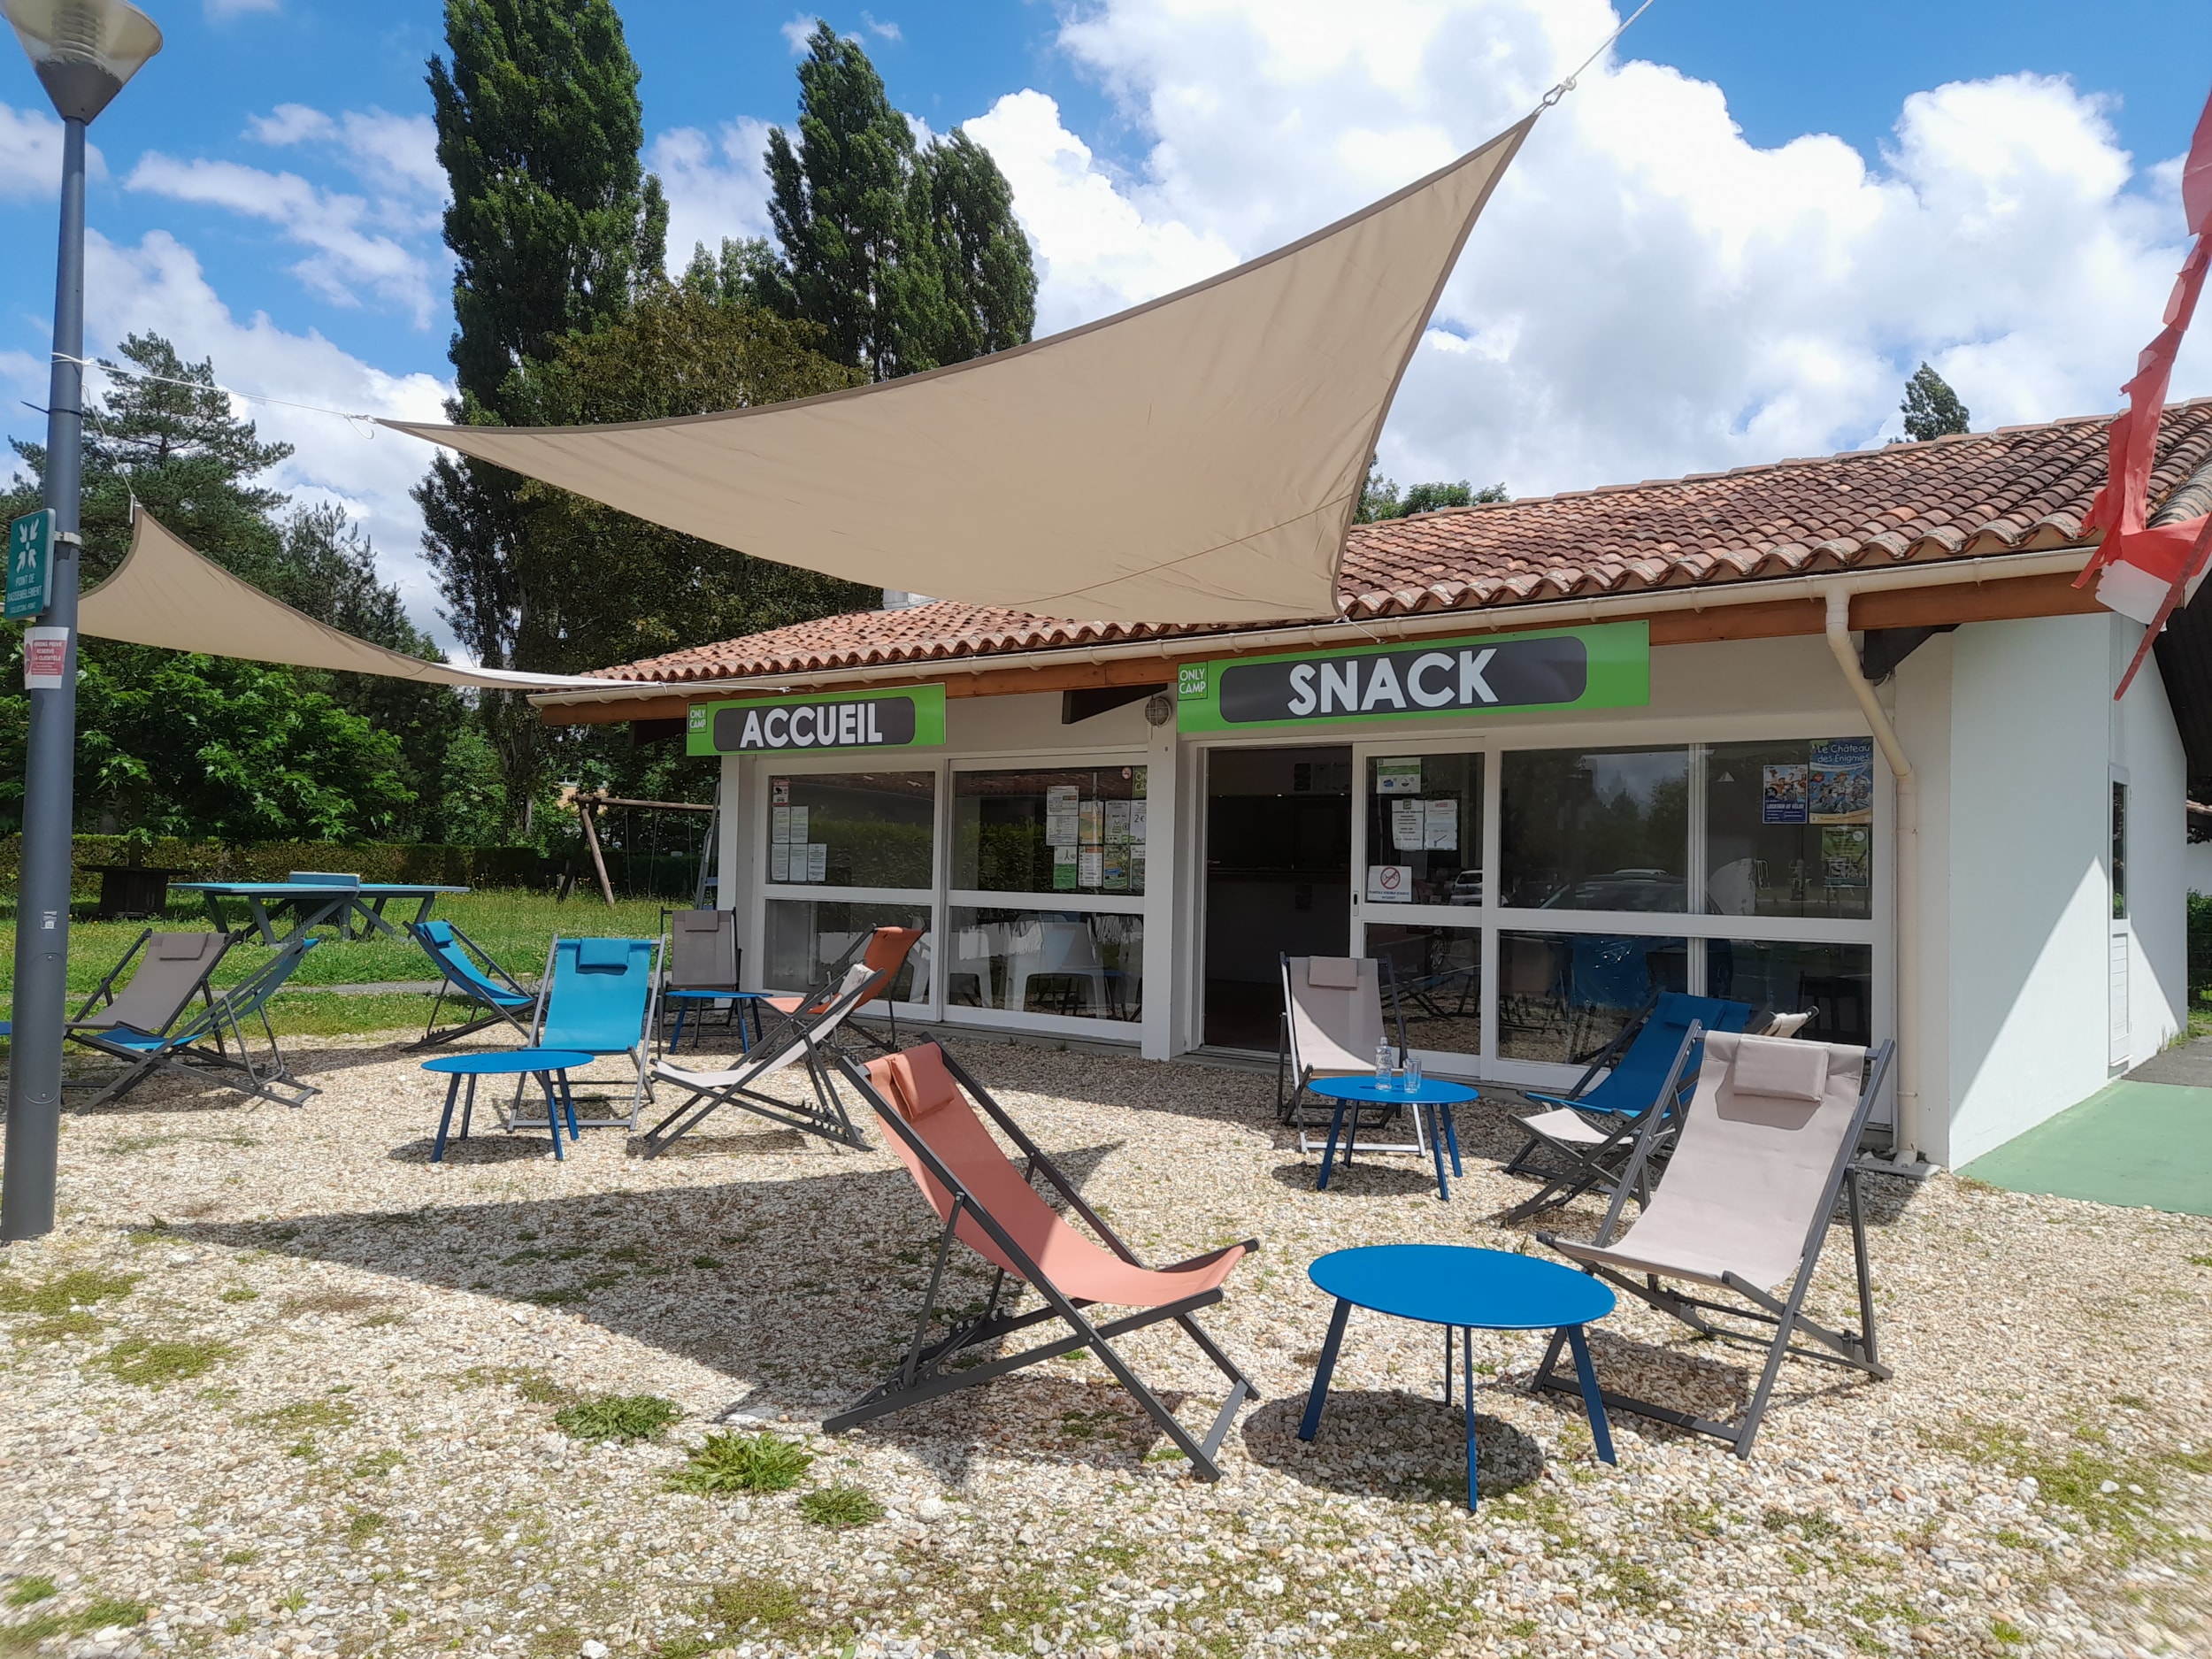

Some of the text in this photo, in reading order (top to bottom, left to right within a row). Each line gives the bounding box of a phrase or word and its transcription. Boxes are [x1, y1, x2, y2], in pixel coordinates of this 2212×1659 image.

[1179, 666, 1205, 682] ONLY
[1179, 680, 1207, 695] CAMP
[1286, 648, 1500, 717] SNACK
[690, 709, 706, 719] ONLY
[689, 718, 706, 729] CAMP
[739, 703, 883, 749] ACCUEIL
[1817, 744, 1870, 754] Le Château
[1834, 753, 1870, 764] Énigmes
[1135, 772, 1147, 781] ON
[1134, 782, 1147, 792] CA
